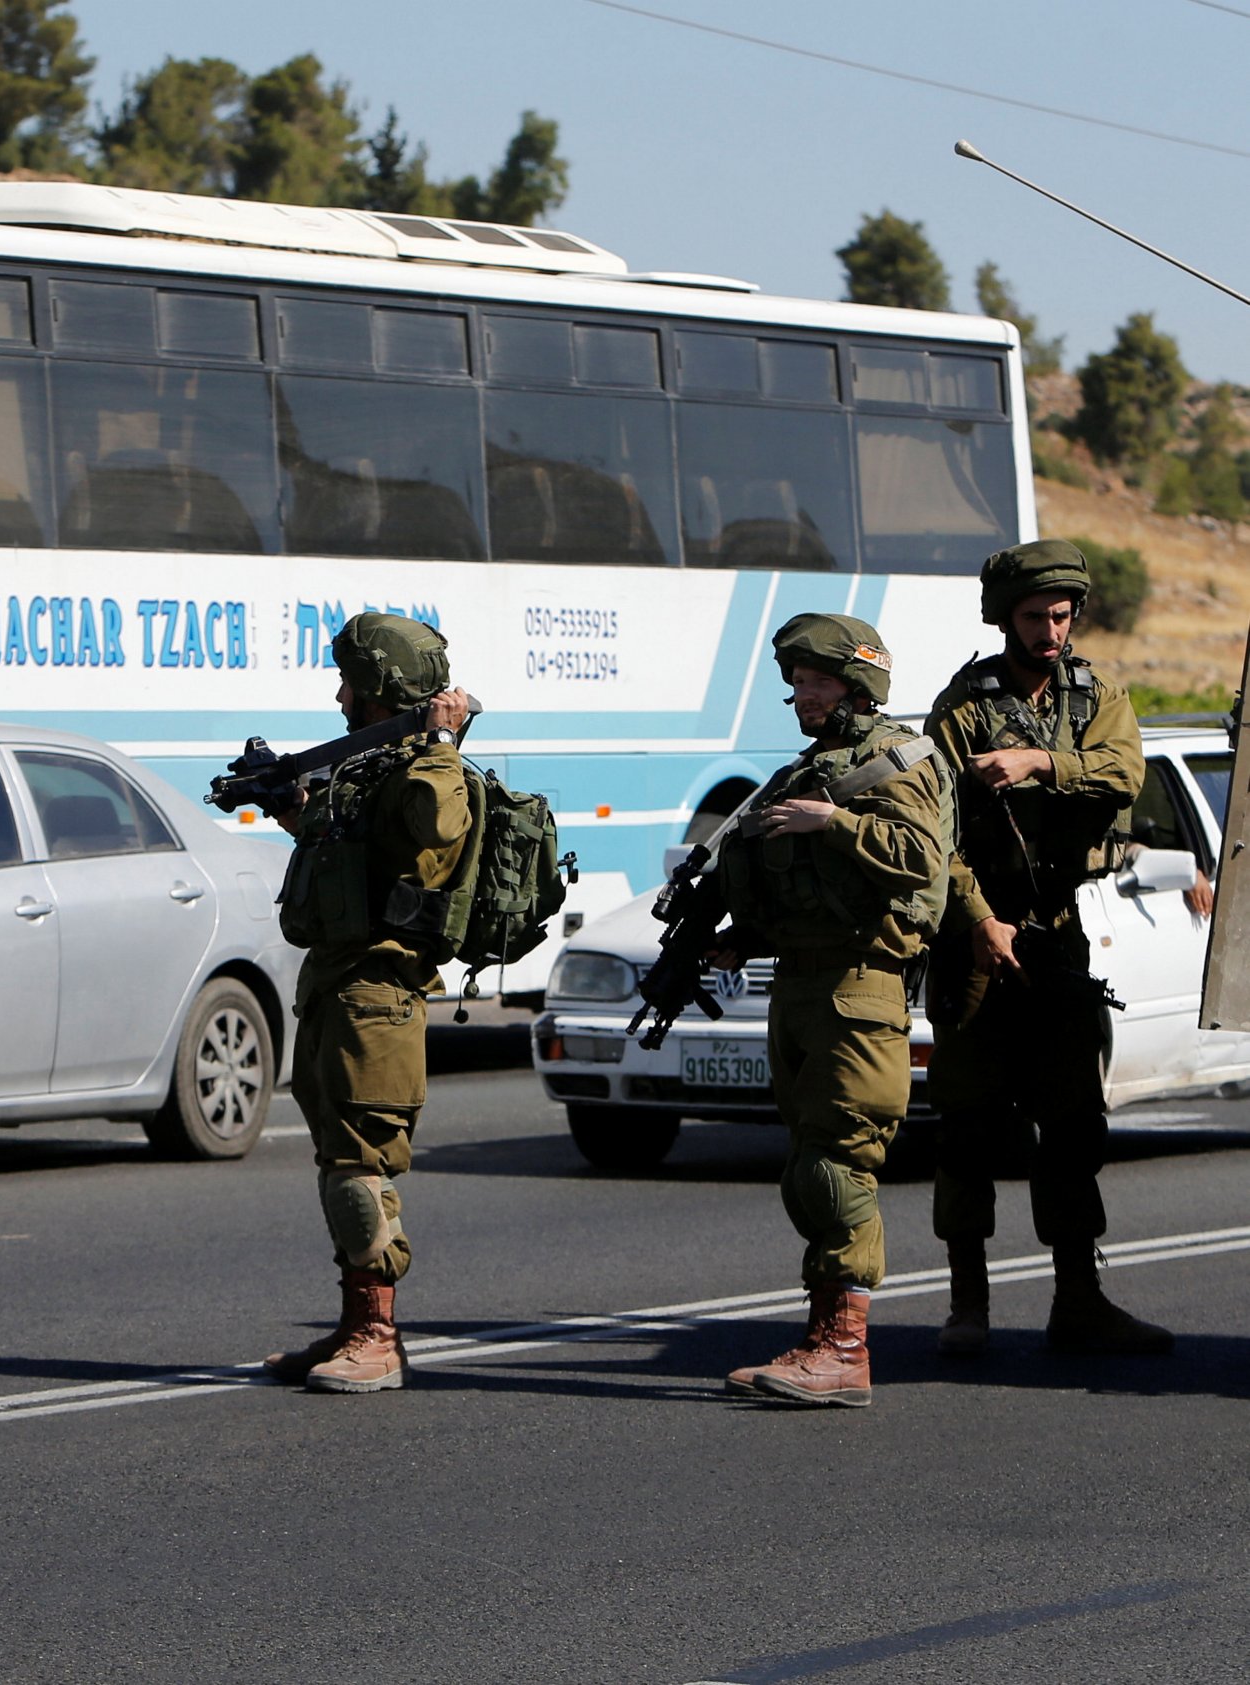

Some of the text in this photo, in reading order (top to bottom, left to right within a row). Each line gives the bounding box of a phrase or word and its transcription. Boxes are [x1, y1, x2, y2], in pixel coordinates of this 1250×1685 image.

[137, 599, 248, 668] TZACH
[525, 606, 618, 638] 050-5335915
[526, 650, 618, 680] 04-9512194
[685, 1056, 766, 1084] 9165390
